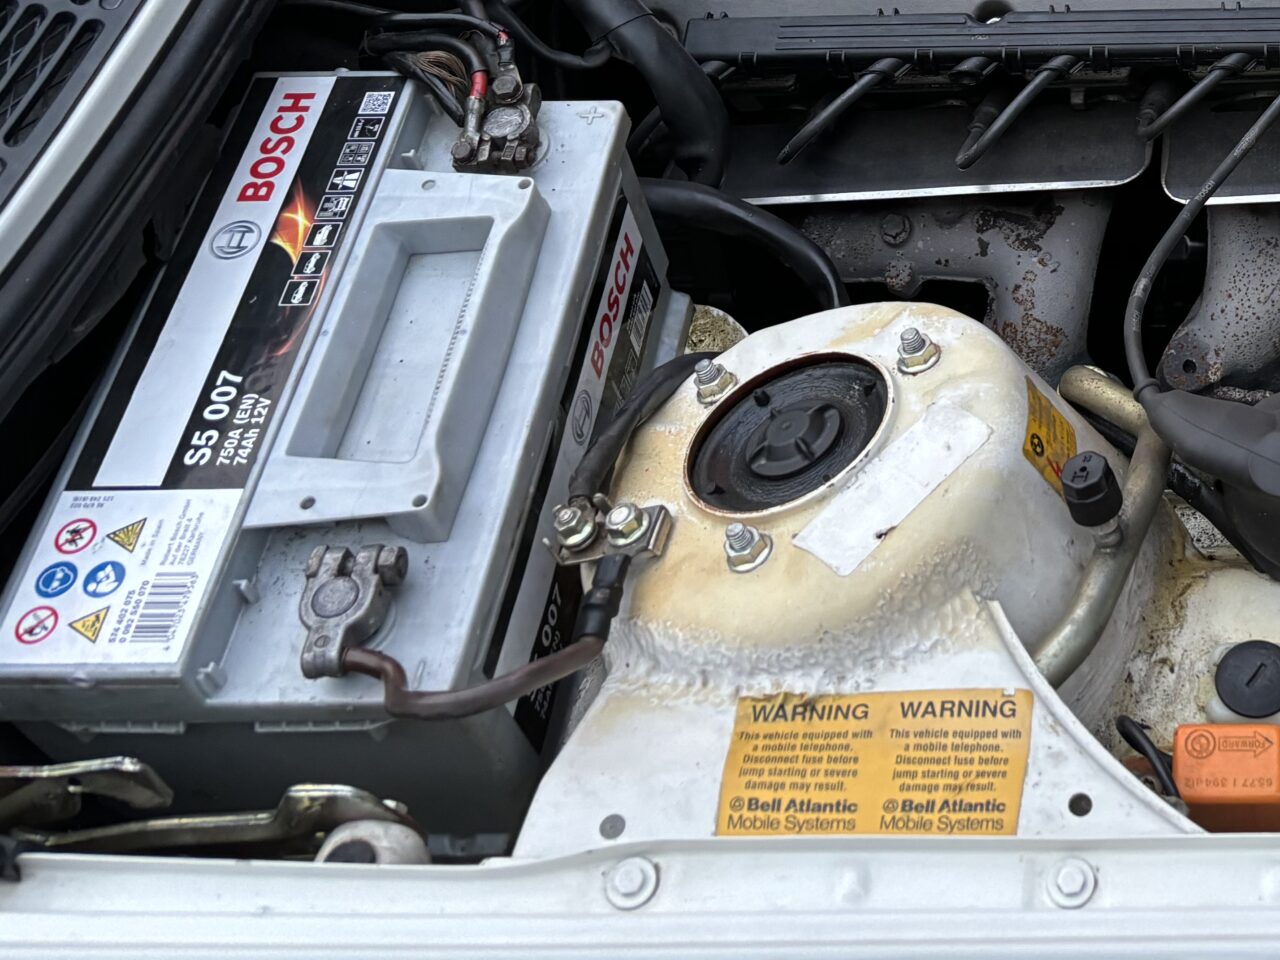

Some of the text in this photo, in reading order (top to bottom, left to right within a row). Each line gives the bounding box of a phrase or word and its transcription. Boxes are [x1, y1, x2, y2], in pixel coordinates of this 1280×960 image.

[236, 92, 317, 203] BOSCH
[590, 231, 635, 381] BOSCH
[183, 370, 244, 467] S5 007
[216, 393, 260, 466] 750A (EN)
[233, 397, 273, 466] 74Ah 12V
[541, 581, 562, 648] 007
[751, 703, 869, 723] WARNING
[900, 699, 1017, 719] WARNING
[738, 729, 873, 741] This vehicle equipped with
[889, 728, 1022, 741] This vehicle equipped with
[752, 741, 854, 754] a mobile telephone.
[904, 741, 1004, 754] a mobile telephone.
[1221, 739, 1267, 749] FORWARD
[742, 754, 859, 765] Disconnect fuse before
[895, 755, 1009, 766] Disconnect fuse before
[738, 767, 858, 779] jump starting or severe
[892, 768, 1007, 781] jump starting or severe
[744, 780, 847, 794] damage may result.
[899, 781, 996, 795] damage may result.
[746, 797, 858, 814] Bell Atlantic
[900, 798, 1006, 814] Bell Atlantic
[727, 814, 856, 834] Mobile Systems
[879, 814, 1004, 834] Mobile Systems
